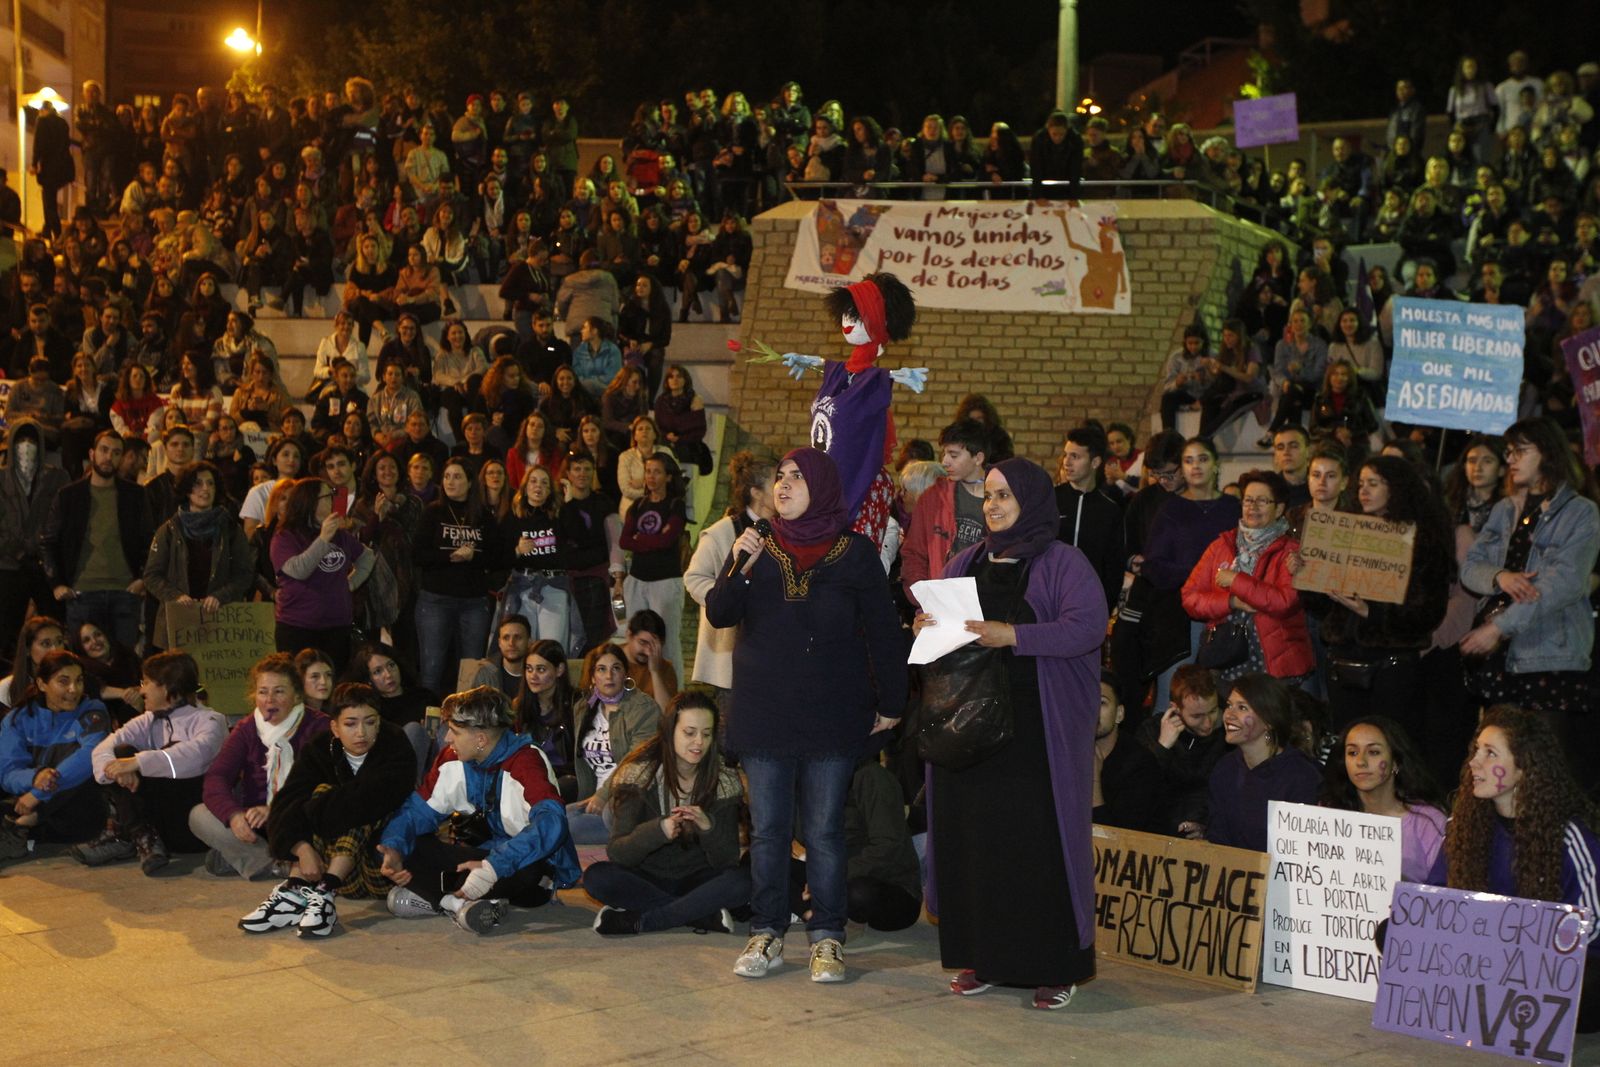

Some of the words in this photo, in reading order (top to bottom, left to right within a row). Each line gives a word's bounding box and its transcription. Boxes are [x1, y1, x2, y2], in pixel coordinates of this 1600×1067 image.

[893, 226, 966, 248] vamos
[973, 221, 1053, 245] unidas
[877, 248, 916, 272] por
[923, 246, 954, 269] los
[961, 247, 1065, 271] derechos
[911, 269, 938, 287] de
[947, 270, 1011, 291] todas
[1401, 306, 1461, 325] MOLESTA
[1496, 318, 1521, 332] UNA
[1401, 327, 1446, 349] MUJER
[1452, 333, 1523, 358] LIBERADA
[1422, 361, 1453, 377] QUE
[1463, 366, 1494, 383] MIL
[442, 526, 483, 541] FEMME
[522, 528, 555, 539] FUCK
[1307, 525, 1326, 540] SE
[1310, 511, 1335, 525] CON
[1338, 516, 1350, 529] EL
[1353, 519, 1408, 535] MACHISMO
[1301, 546, 1328, 561] CON
[1329, 552, 1341, 565] EL
[201, 649, 243, 660] HARTAS
[1278, 810, 1330, 836] MOLARÍA
[1334, 818, 1352, 838] NO
[1359, 824, 1395, 842] TENER
[1276, 838, 1299, 856] QUE
[1307, 840, 1345, 861] MIRAR
[1355, 846, 1384, 867] PARA
[1095, 846, 1178, 898] MAN'S
[1183, 860, 1266, 916] PLACE
[1274, 861, 1323, 886] ATRÁS
[1329, 869, 1345, 885] AL
[1352, 871, 1388, 892] ABRIR
[1296, 888, 1313, 906] EL
[1272, 908, 1313, 935] PRODUCE
[1390, 891, 1469, 935] SOMOS
[1498, 902, 1585, 956] GRITO
[1117, 891, 1260, 982] RESISTANCE
[1275, 940, 1290, 954] EN
[1274, 957, 1293, 975] LA
[1303, 943, 1382, 984] LIBERTA
[1418, 941, 1453, 977] LAS
[1499, 947, 1529, 990] YA
[1535, 951, 1580, 993] NO
[1475, 983, 1572, 1064] VOZ
